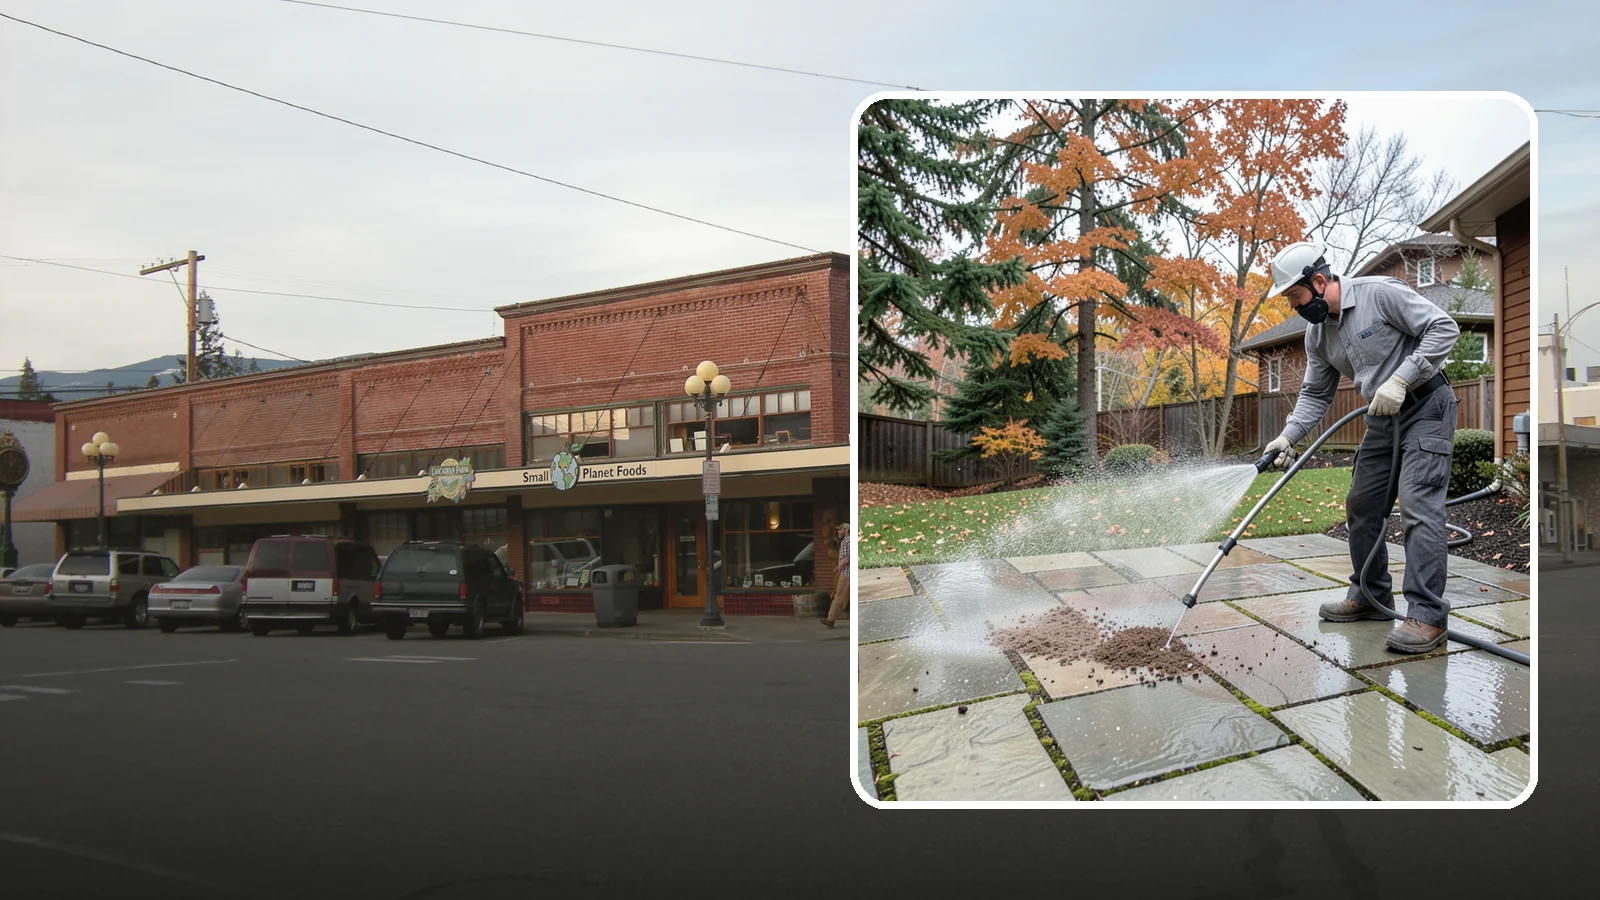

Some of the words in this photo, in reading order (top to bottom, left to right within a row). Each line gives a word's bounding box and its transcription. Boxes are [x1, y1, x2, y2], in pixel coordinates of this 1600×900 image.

[523, 472, 548, 482] Small
[582, 468, 614, 479] Planet
[617, 464, 646, 476] Foods
